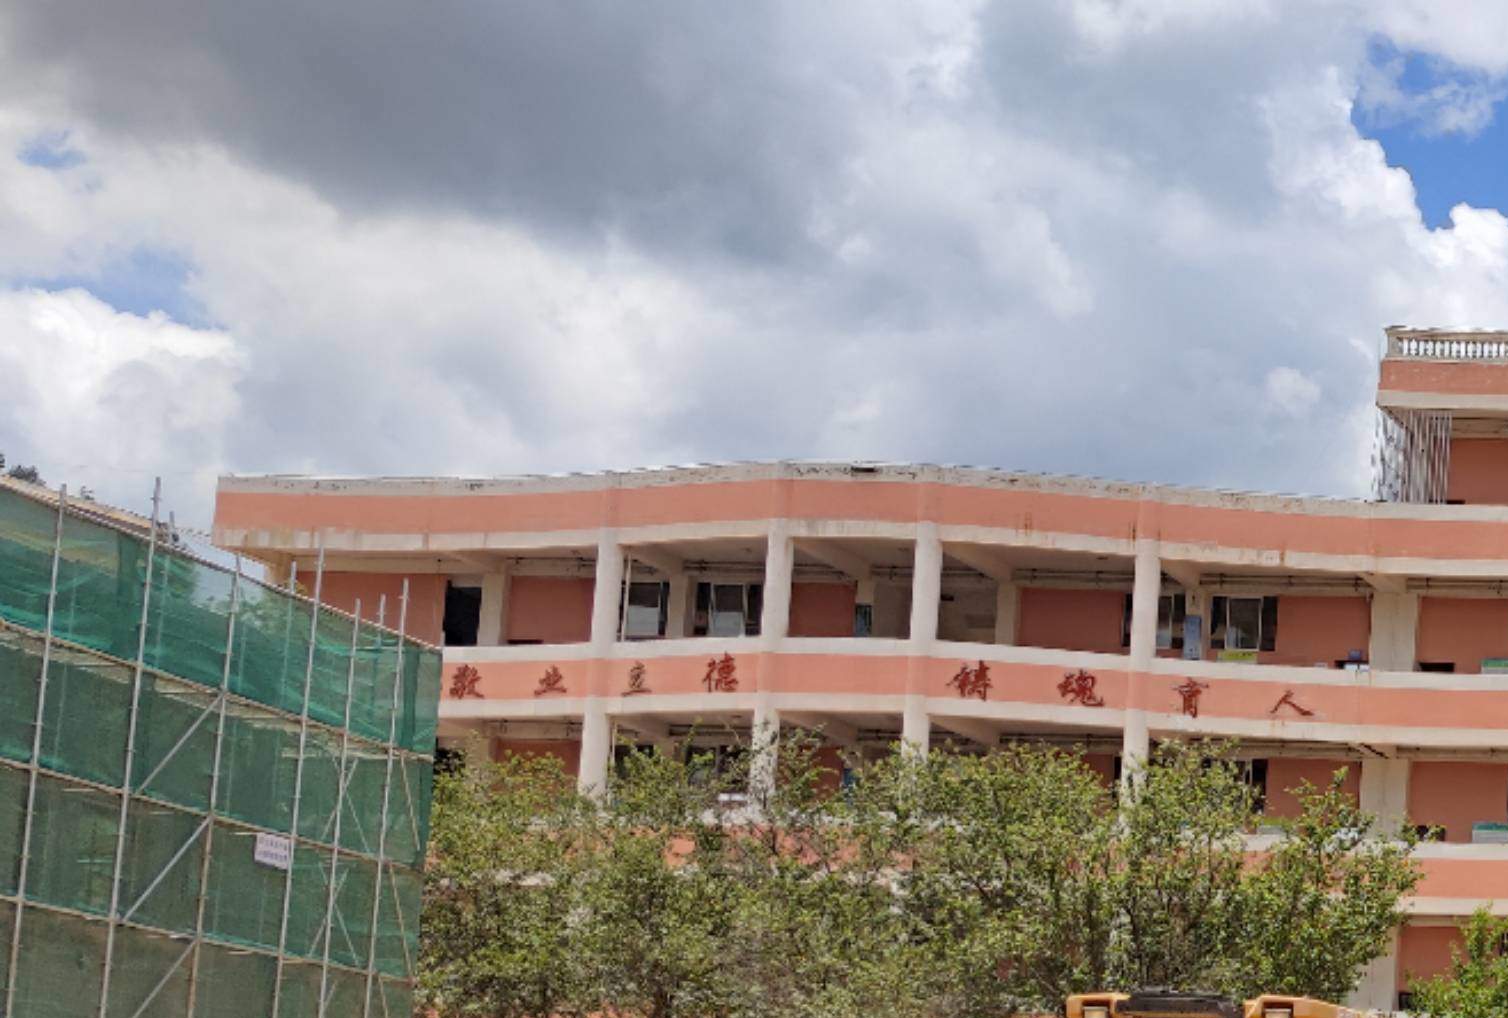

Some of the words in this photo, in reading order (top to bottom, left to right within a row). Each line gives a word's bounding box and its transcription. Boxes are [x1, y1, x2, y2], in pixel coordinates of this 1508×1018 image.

[450, 652, 739, 699] 敬业立德
[946, 660, 1315, 718] 铸魂育人
